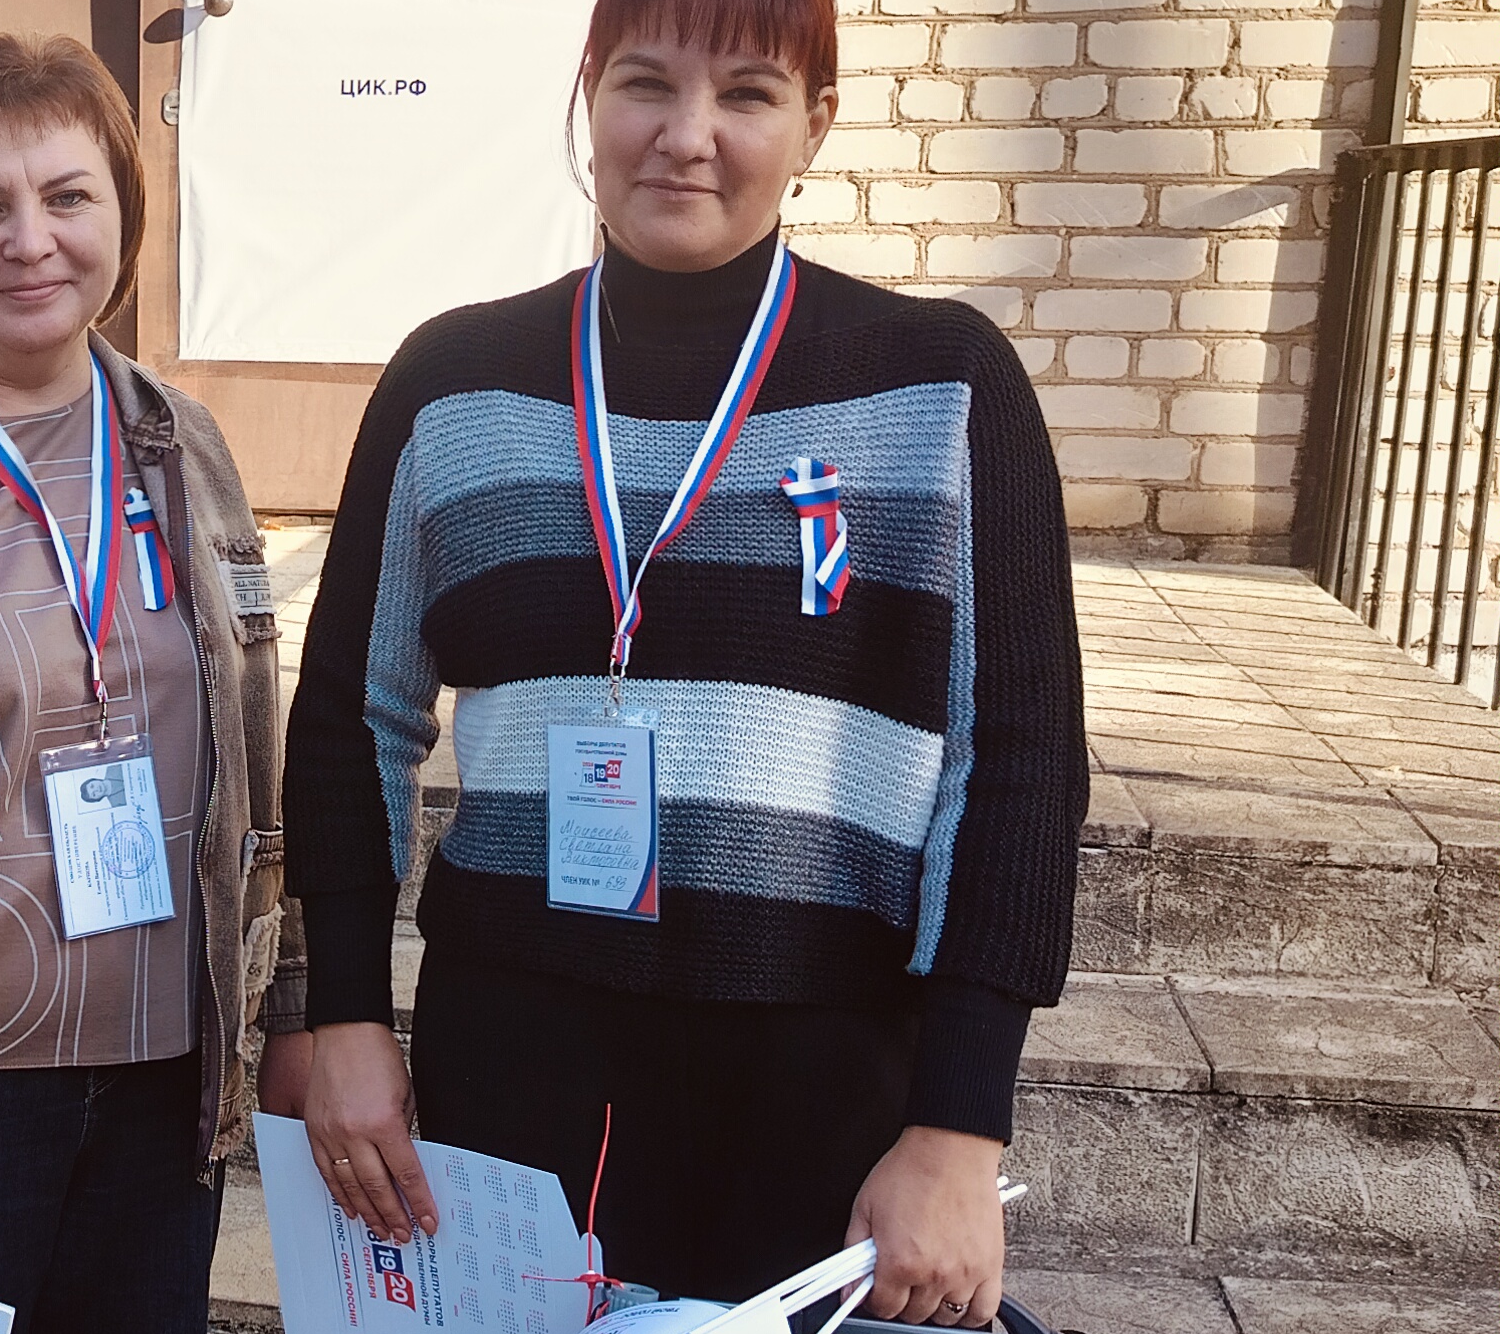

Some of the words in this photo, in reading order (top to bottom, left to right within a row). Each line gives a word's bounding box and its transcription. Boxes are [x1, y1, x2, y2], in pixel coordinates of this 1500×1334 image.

[341, 75, 427, 100] ЦИК.РФ
[584, 773, 594, 783] 18
[595, 768, 606, 779] 19
[607, 764, 620, 775] 20
[332, 1207, 344, 1242] ГОЛОС
[377, 1247, 396, 1272] 19
[424, 1234, 437, 1265] БОРЫ
[340, 1251, 350, 1280] СИЛА
[362, 1245, 376, 1299] СЕНТЯБРЯ
[388, 1273, 408, 1304] 20
[427, 1264, 445, 1327] ДЕПУТАТОВ
[343, 1281, 357, 1327] РОССИИ!
[420, 1298, 430, 1326] ДУМЫ
